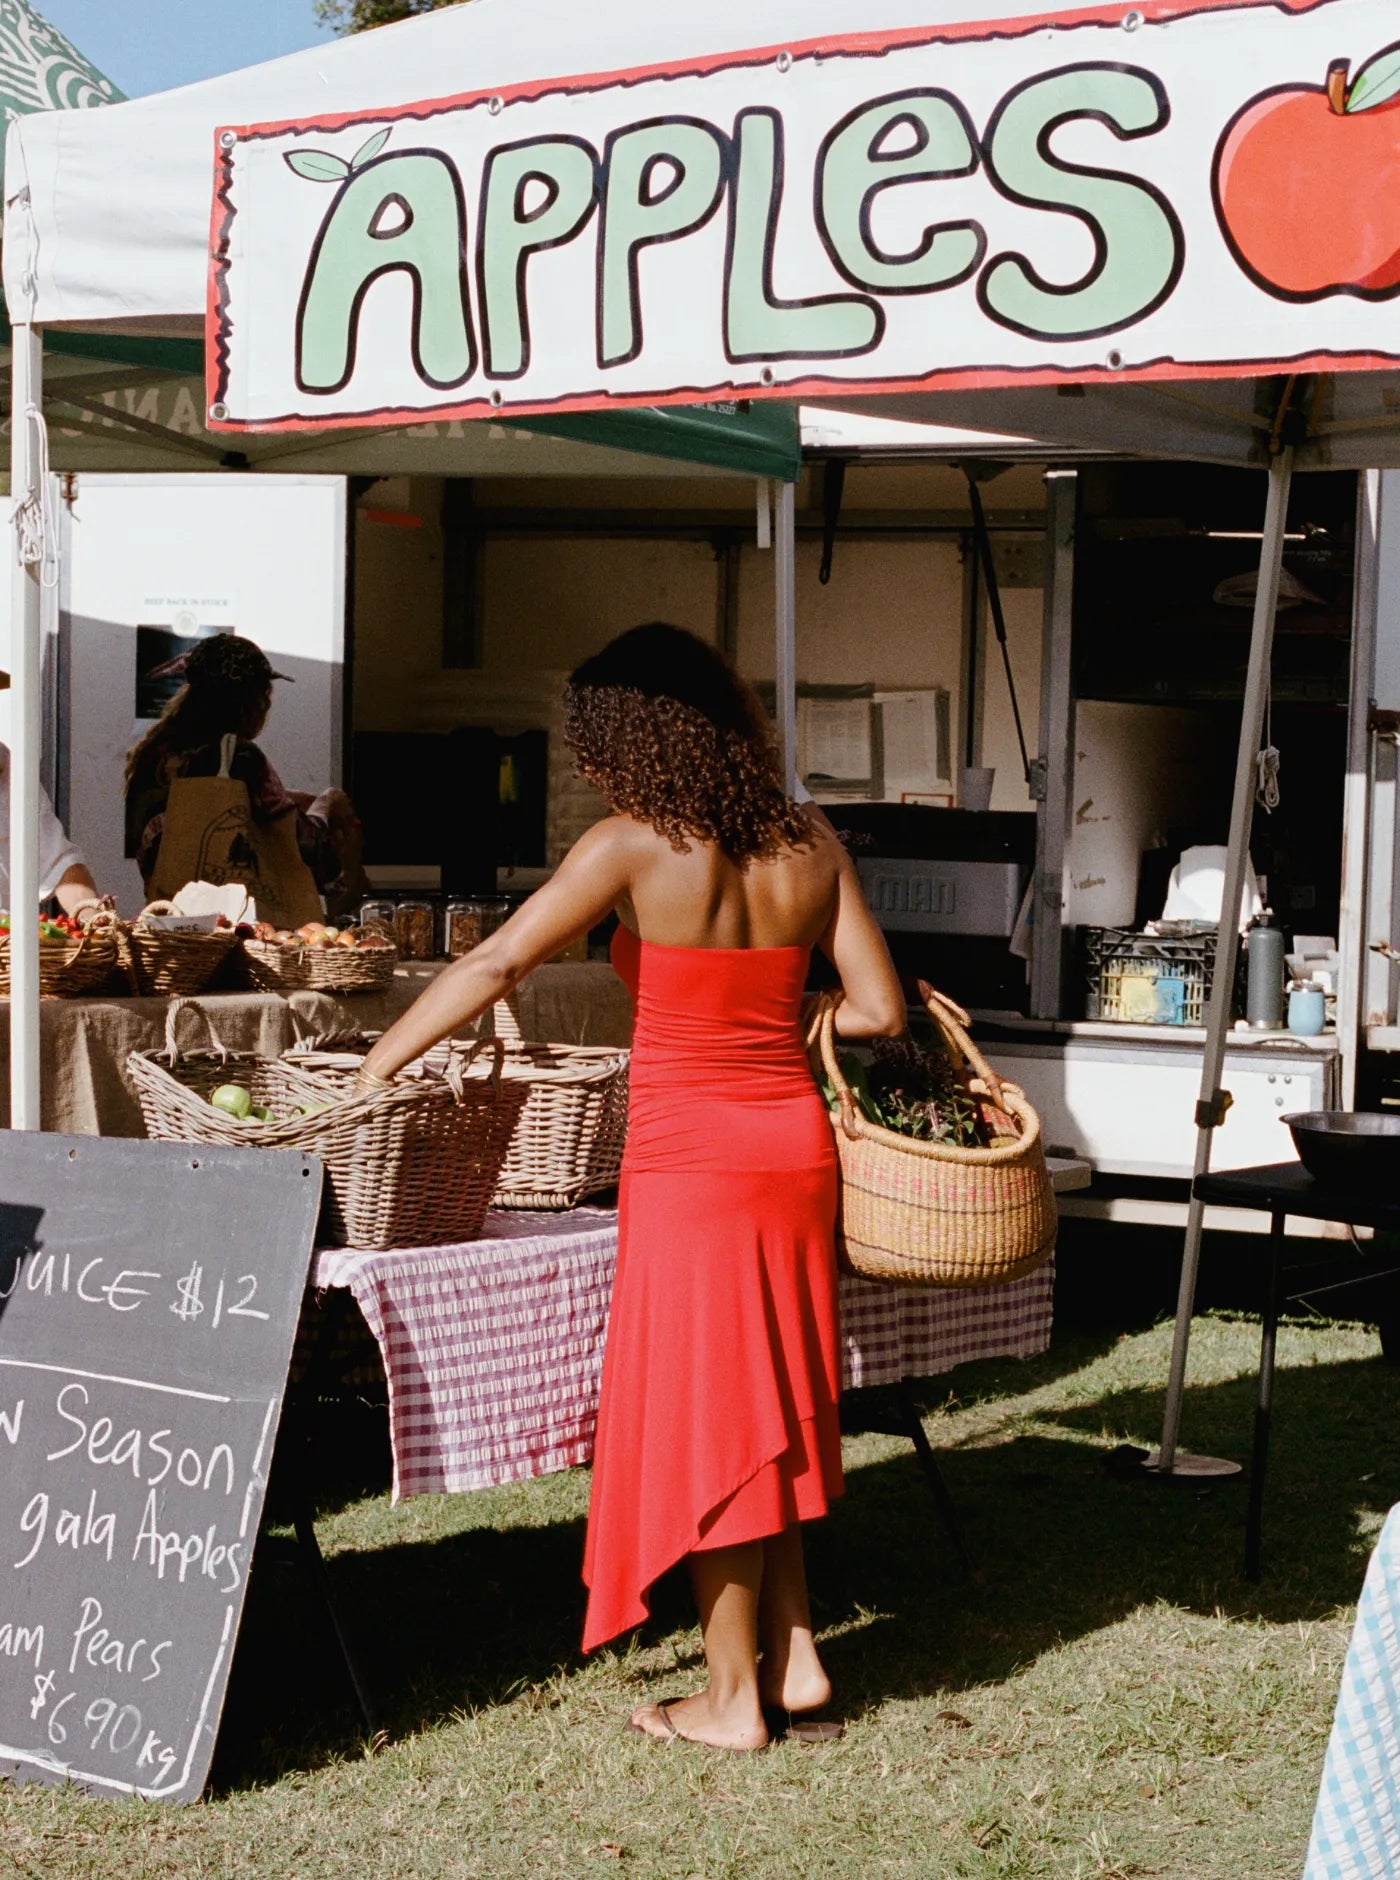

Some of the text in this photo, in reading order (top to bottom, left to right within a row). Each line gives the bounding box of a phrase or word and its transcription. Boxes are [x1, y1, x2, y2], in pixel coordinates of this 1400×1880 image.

[169, 1260, 270, 1328] $12
[47, 1384, 234, 1494] Season
[14, 1488, 242, 1593] gala Apples
[69, 1597, 172, 1682] Pears
